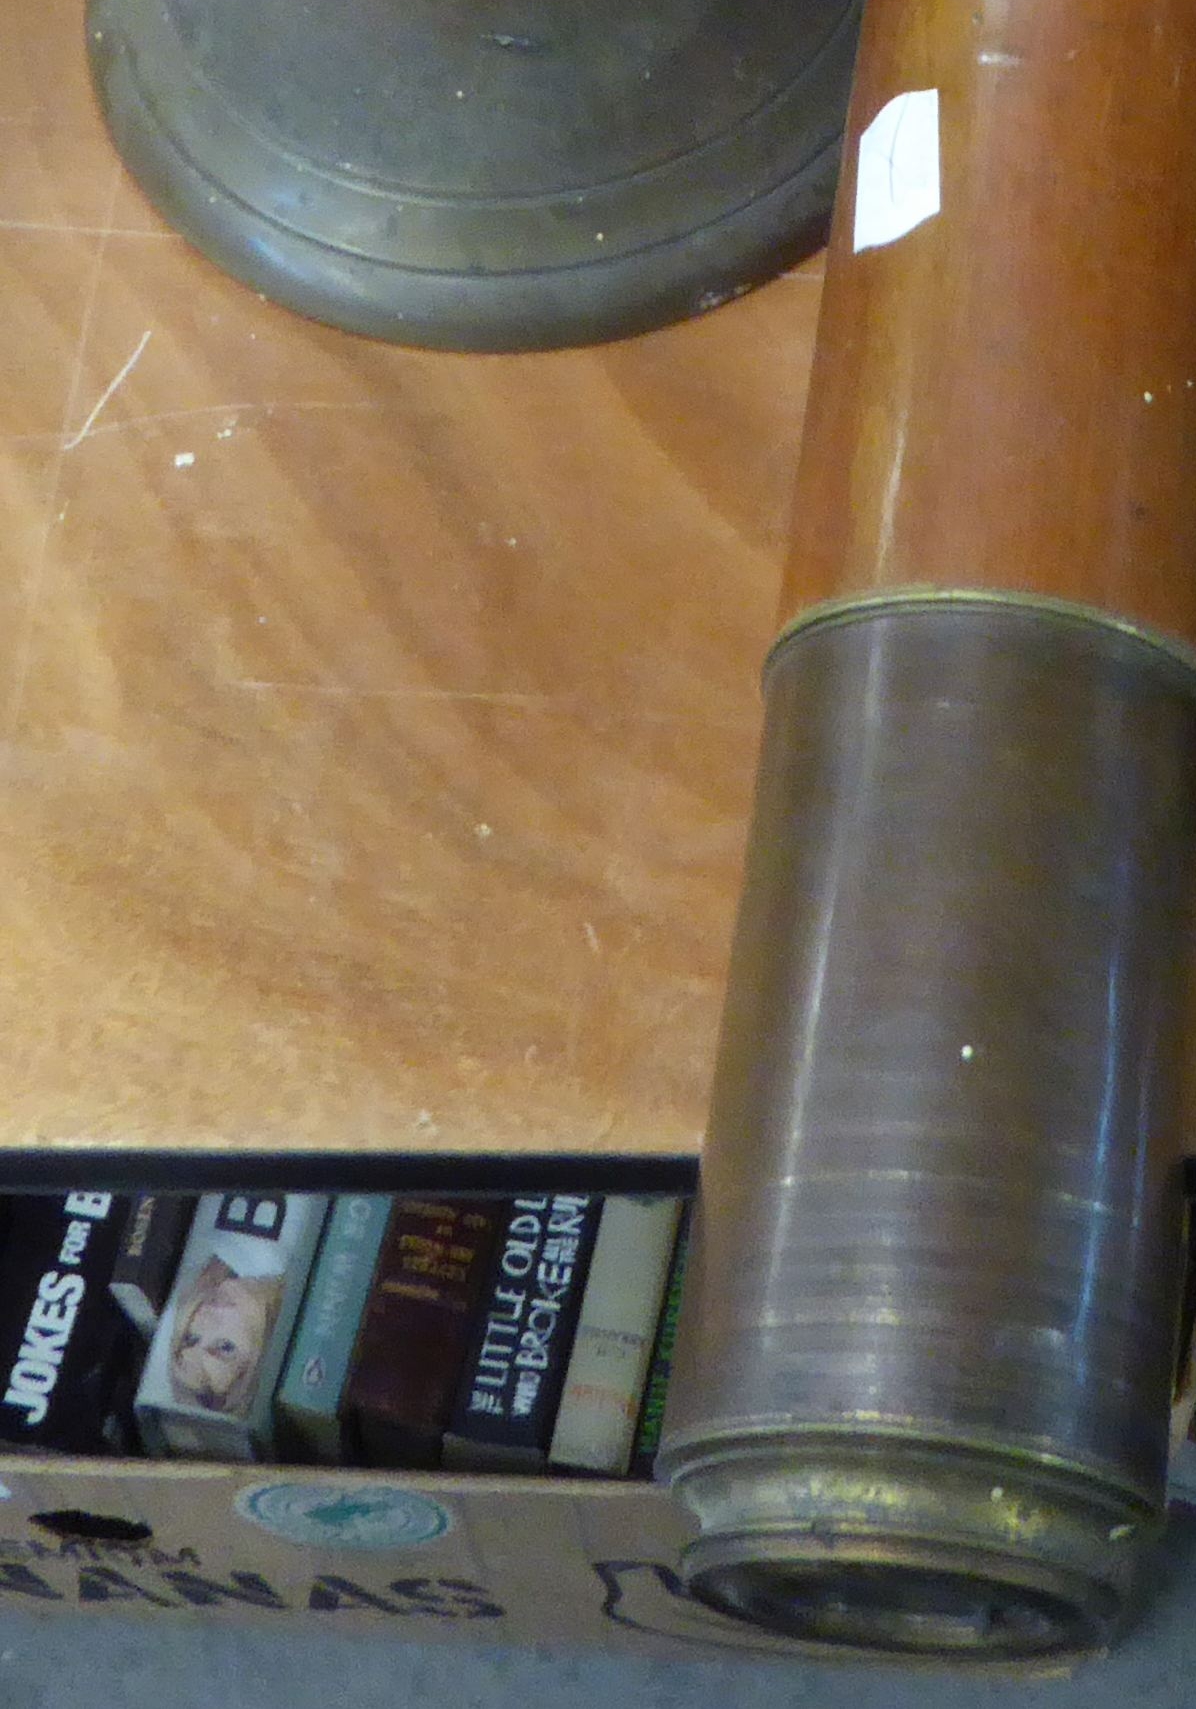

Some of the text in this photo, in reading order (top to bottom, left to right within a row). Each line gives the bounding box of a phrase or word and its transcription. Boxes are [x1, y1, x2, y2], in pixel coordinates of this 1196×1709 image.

[3, 1270, 87, 1426] JOKES
[58, 1220, 91, 1266] FOR
[475, 1284, 527, 1387] LITTLE
[502, 1214, 542, 1278] OLD
[514, 1261, 573, 1370] BROKE
